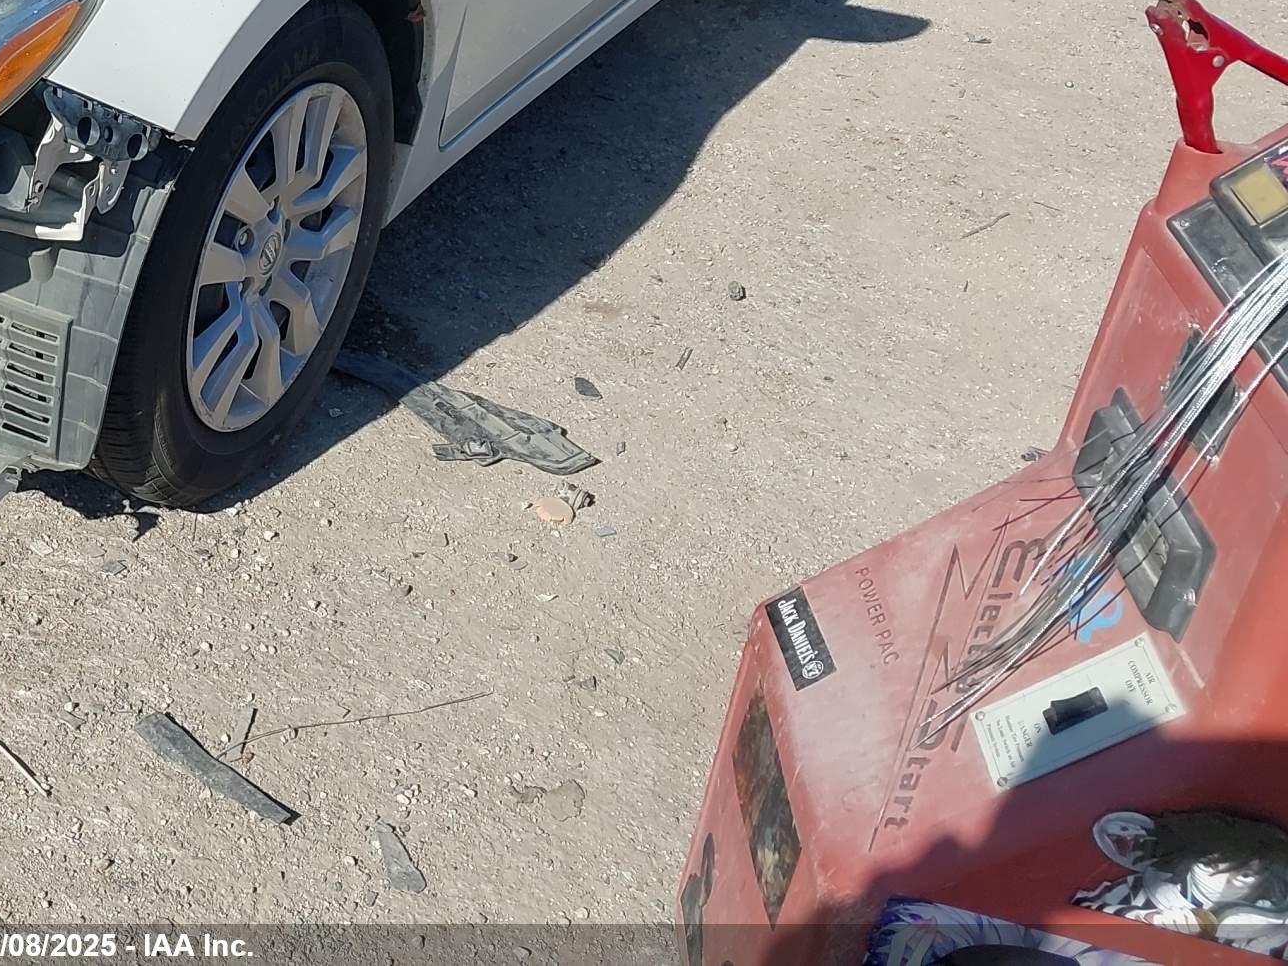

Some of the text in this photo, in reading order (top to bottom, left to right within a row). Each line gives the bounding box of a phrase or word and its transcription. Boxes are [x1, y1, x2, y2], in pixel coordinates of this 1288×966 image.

[777, 597, 799, 627] JACK
[855, 566, 900, 665] POWER PAC
[1127, 659, 1153, 706] COMPRESSOR
[1144, 671, 1157, 685] AIR
[1033, 722, 1042, 734] ON
